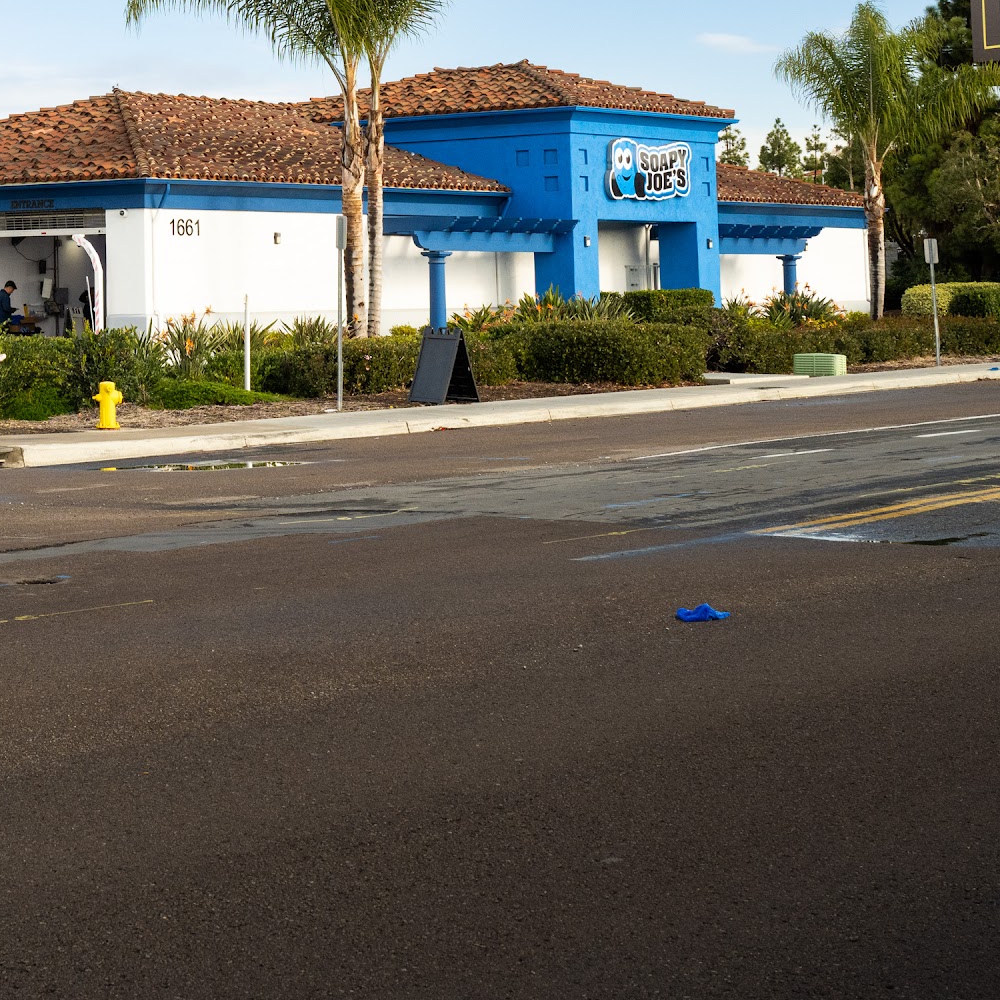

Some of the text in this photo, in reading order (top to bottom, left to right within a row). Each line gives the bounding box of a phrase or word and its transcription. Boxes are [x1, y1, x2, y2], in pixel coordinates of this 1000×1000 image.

[640, 149, 687, 172] SOAPY
[646, 168, 686, 191] JOE'S
[10, 199, 55, 209] ENTRANCE
[169, 218, 200, 236] 1661
